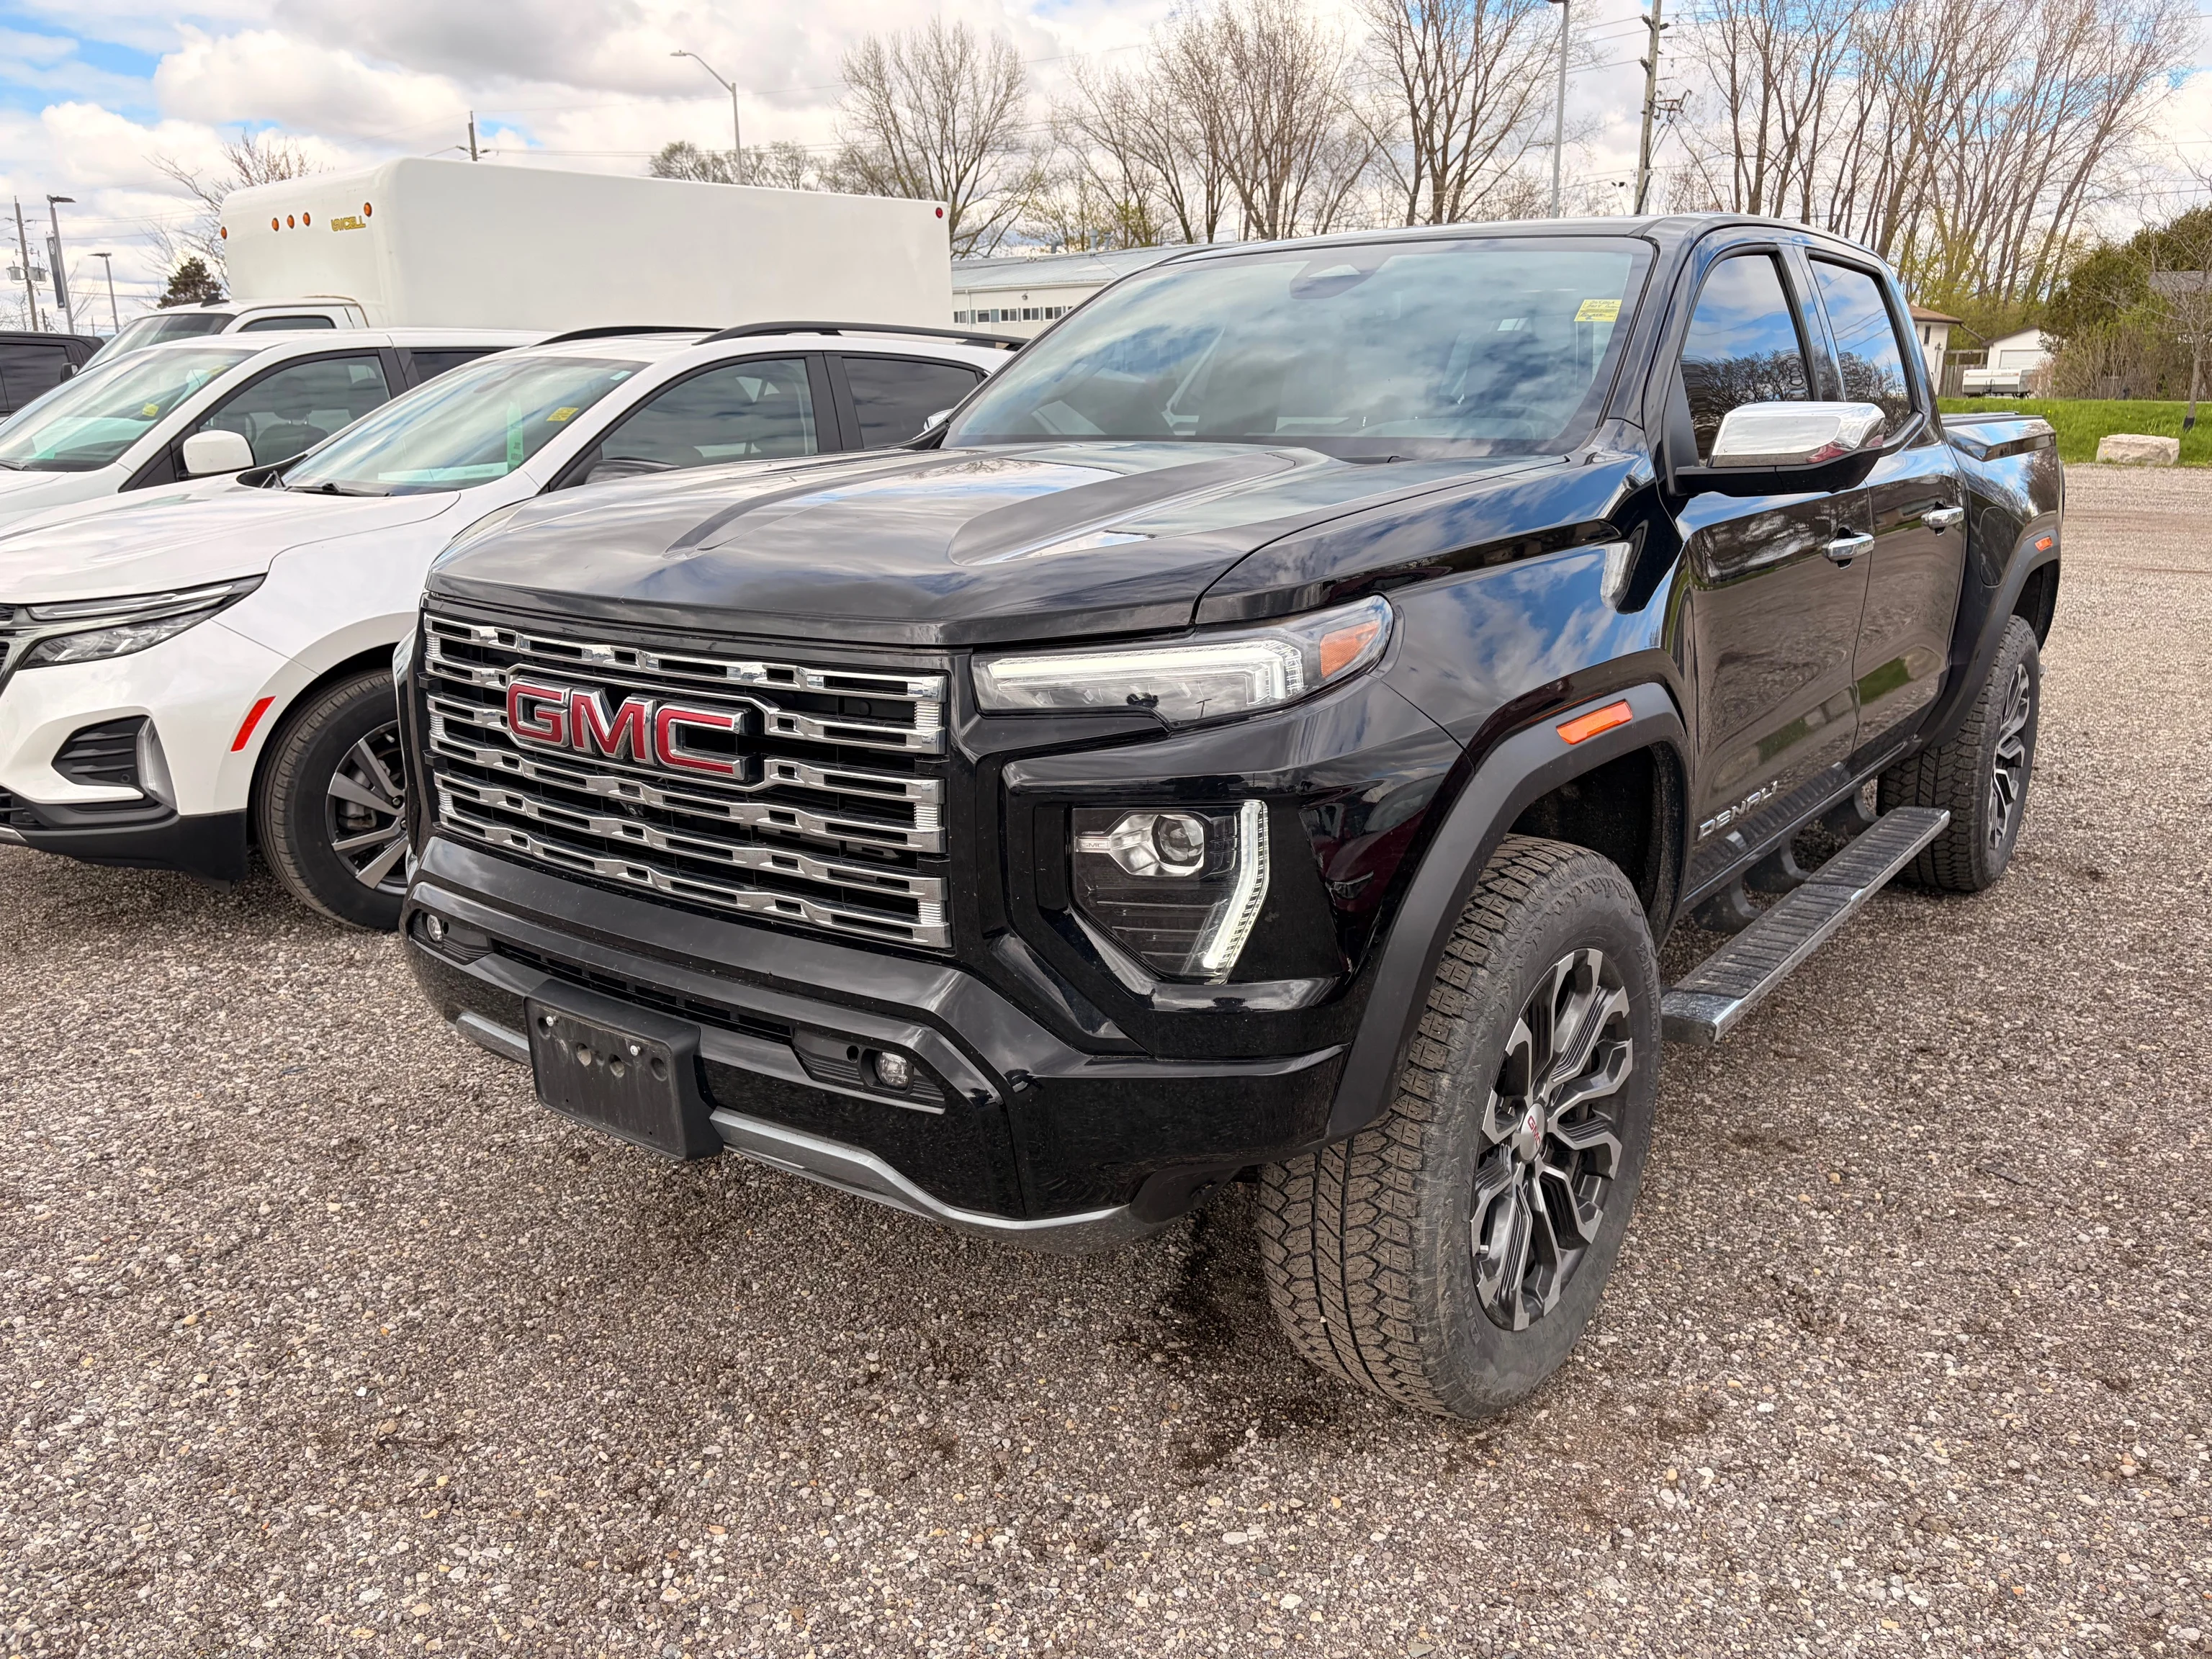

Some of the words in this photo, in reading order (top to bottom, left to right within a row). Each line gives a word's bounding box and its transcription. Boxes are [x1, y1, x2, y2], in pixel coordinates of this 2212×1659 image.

[508, 677, 747, 781] GMC
[1696, 781, 1778, 841] DENALI
[1527, 1115, 1541, 1148] GMC
